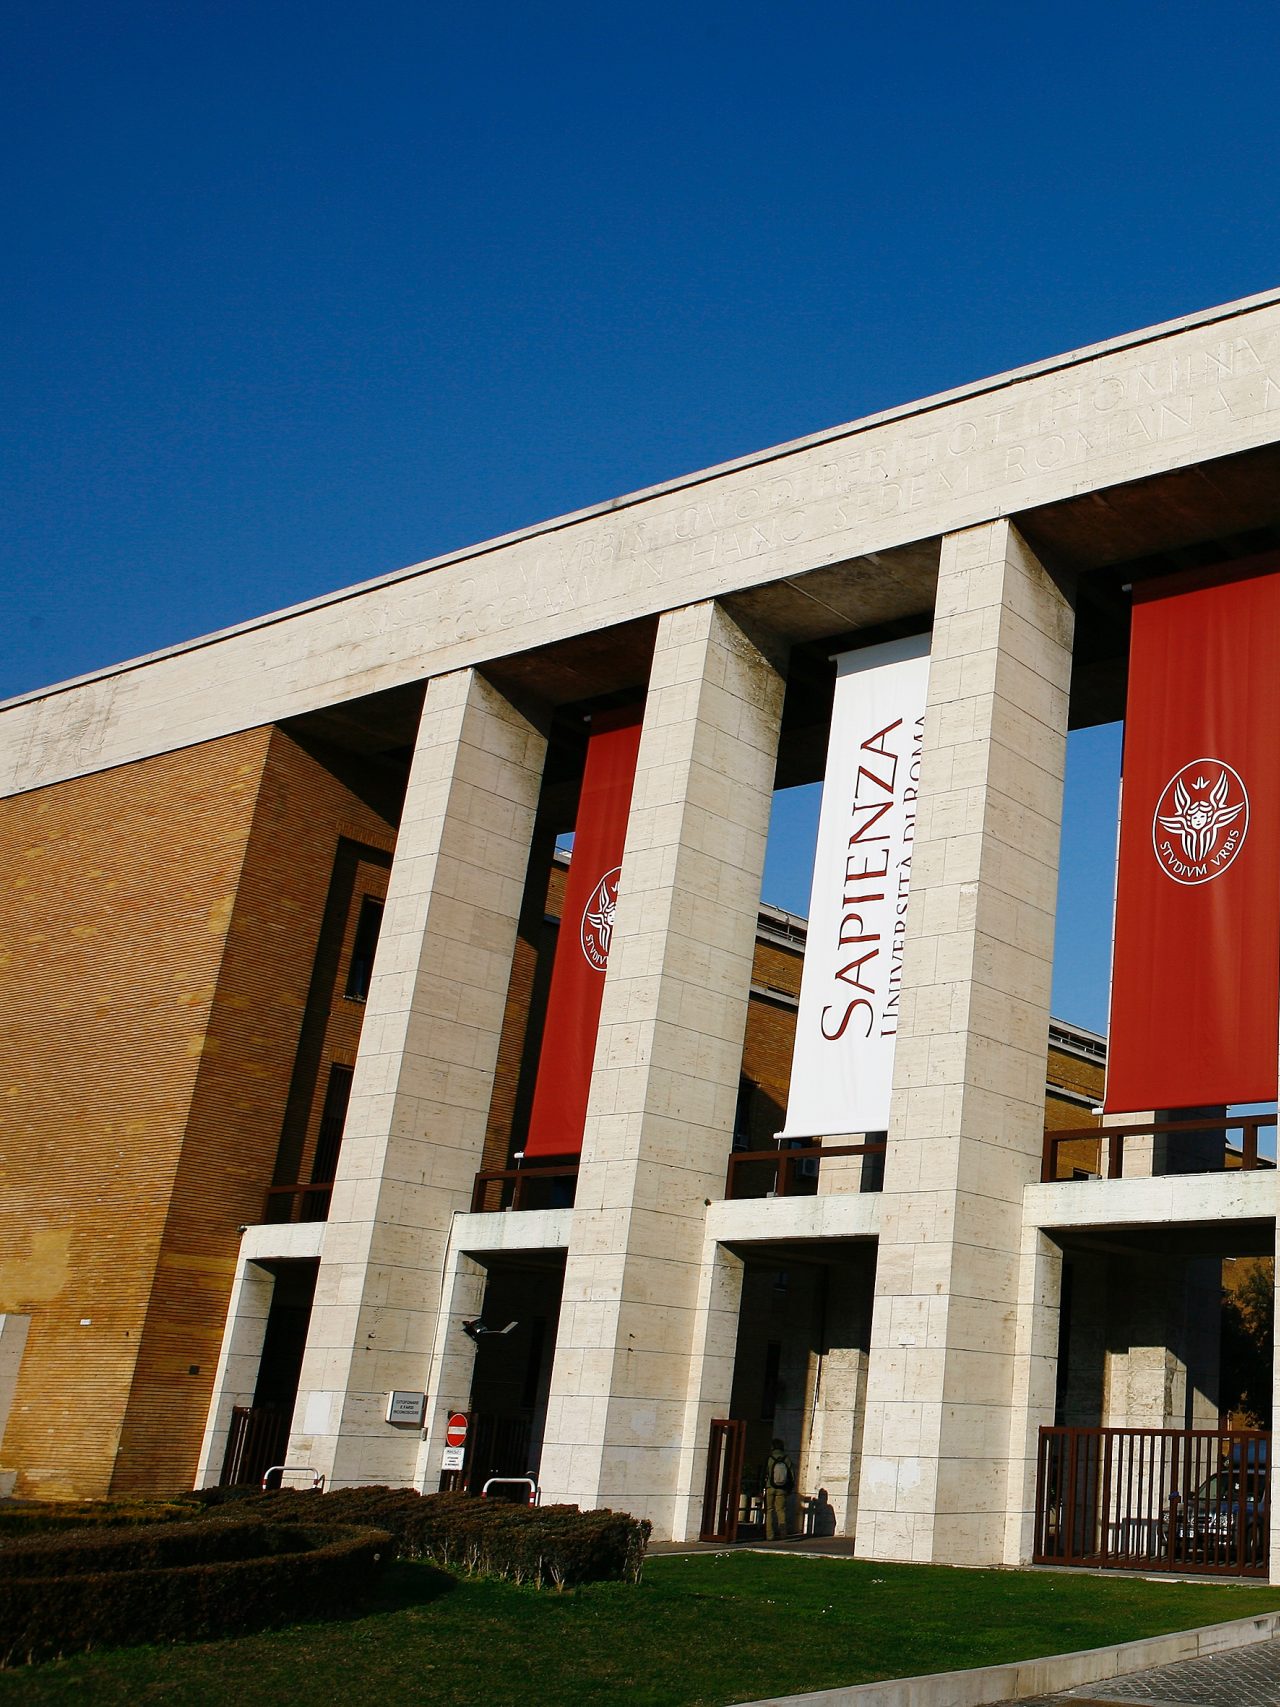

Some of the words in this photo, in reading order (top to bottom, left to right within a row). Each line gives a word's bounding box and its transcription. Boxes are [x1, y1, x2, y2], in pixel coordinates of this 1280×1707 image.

[1004, 387, 1235, 481] ROMANA
[820, 716, 903, 1043] SAPIENZA
[1160, 841, 1208, 878] STVDIVM
[1210, 829, 1240, 866] VRBIS
